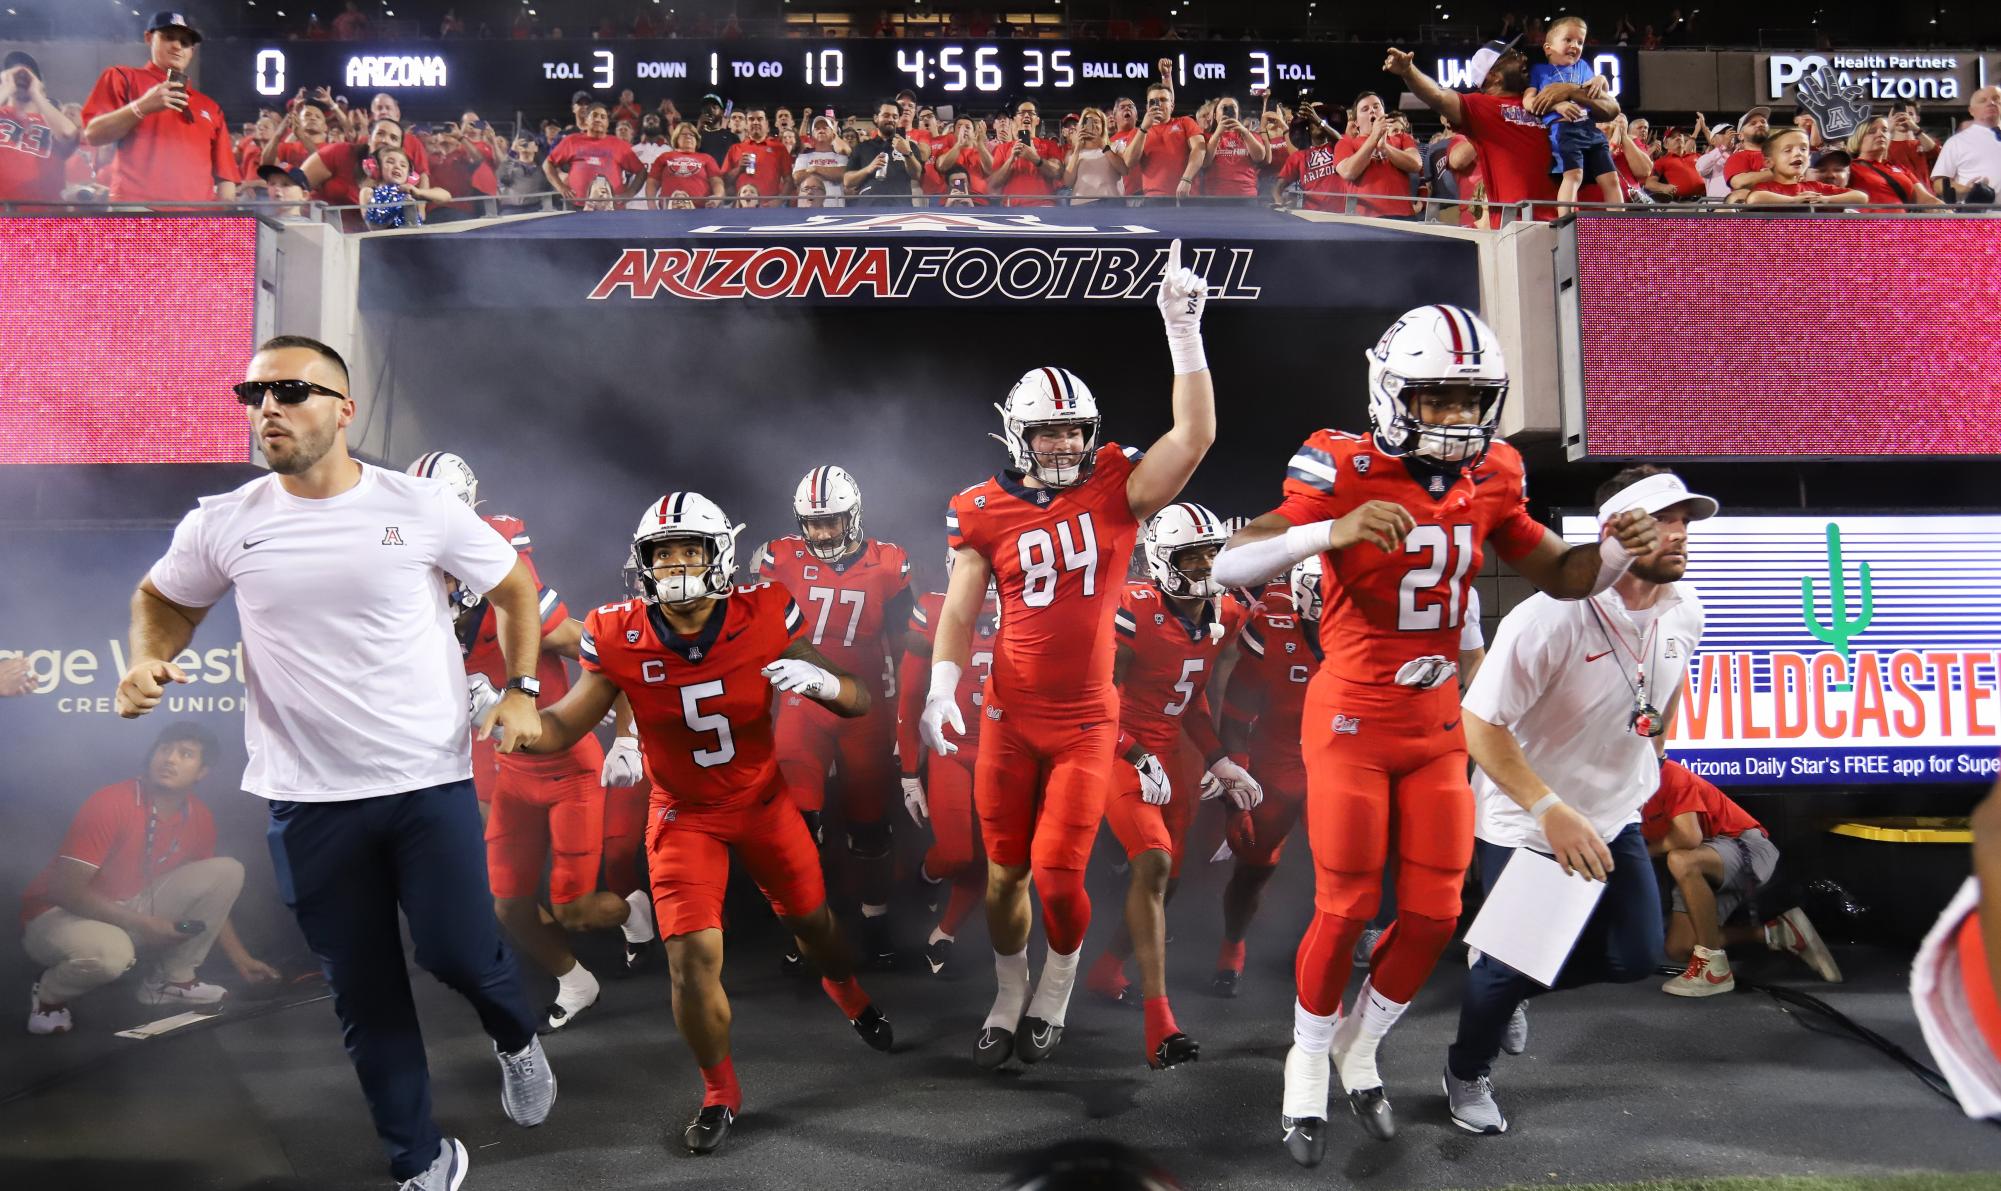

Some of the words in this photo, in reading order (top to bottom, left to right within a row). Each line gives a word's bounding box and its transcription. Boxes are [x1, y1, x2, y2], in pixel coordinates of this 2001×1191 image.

[256, 49, 285, 95] 0
[346, 56, 446, 87] ARIZONA
[543, 63, 583, 79] T.O.L
[593, 50, 614, 88] 3
[637, 62, 686, 78] DOWN
[710, 52, 718, 85] 1
[732, 61, 755, 77] TO
[758, 61, 782, 77] GO
[805, 50, 843, 87] 10
[897, 47, 1002, 91] 4:56
[1023, 50, 1073, 87] 35
[1083, 63, 1122, 78] BALL
[1126, 63, 1148, 78] ON
[1178, 53, 1186, 87] 1
[1193, 63, 1226, 80] QTR
[1249, 52, 1270, 89] 3
[1276, 64, 1315, 80] T.O.L
[1834, 55, 1885, 69] Health
[1890, 55, 1957, 69] Partners
[587, 247, 892, 299] ARIZONA
[889, 247, 1262, 300] FOOTBALL
[803, 565, 819, 580] C
[1017, 512, 1099, 608] 84
[1398, 524, 1473, 632] 21
[809, 586, 865, 647] 77
[642, 660, 665, 683] C
[1164, 658, 1205, 716] 5
[1289, 665, 1309, 683] C
[680, 680, 735, 768] 5
[1679, 758, 1741, 776] Arizona
[1745, 757, 1787, 778] Daily
[1791, 756, 1840, 776] Star's
[1844, 755, 1889, 774] FREE
[1893, 758, 1925, 777] app
[1929, 755, 1954, 773] for
